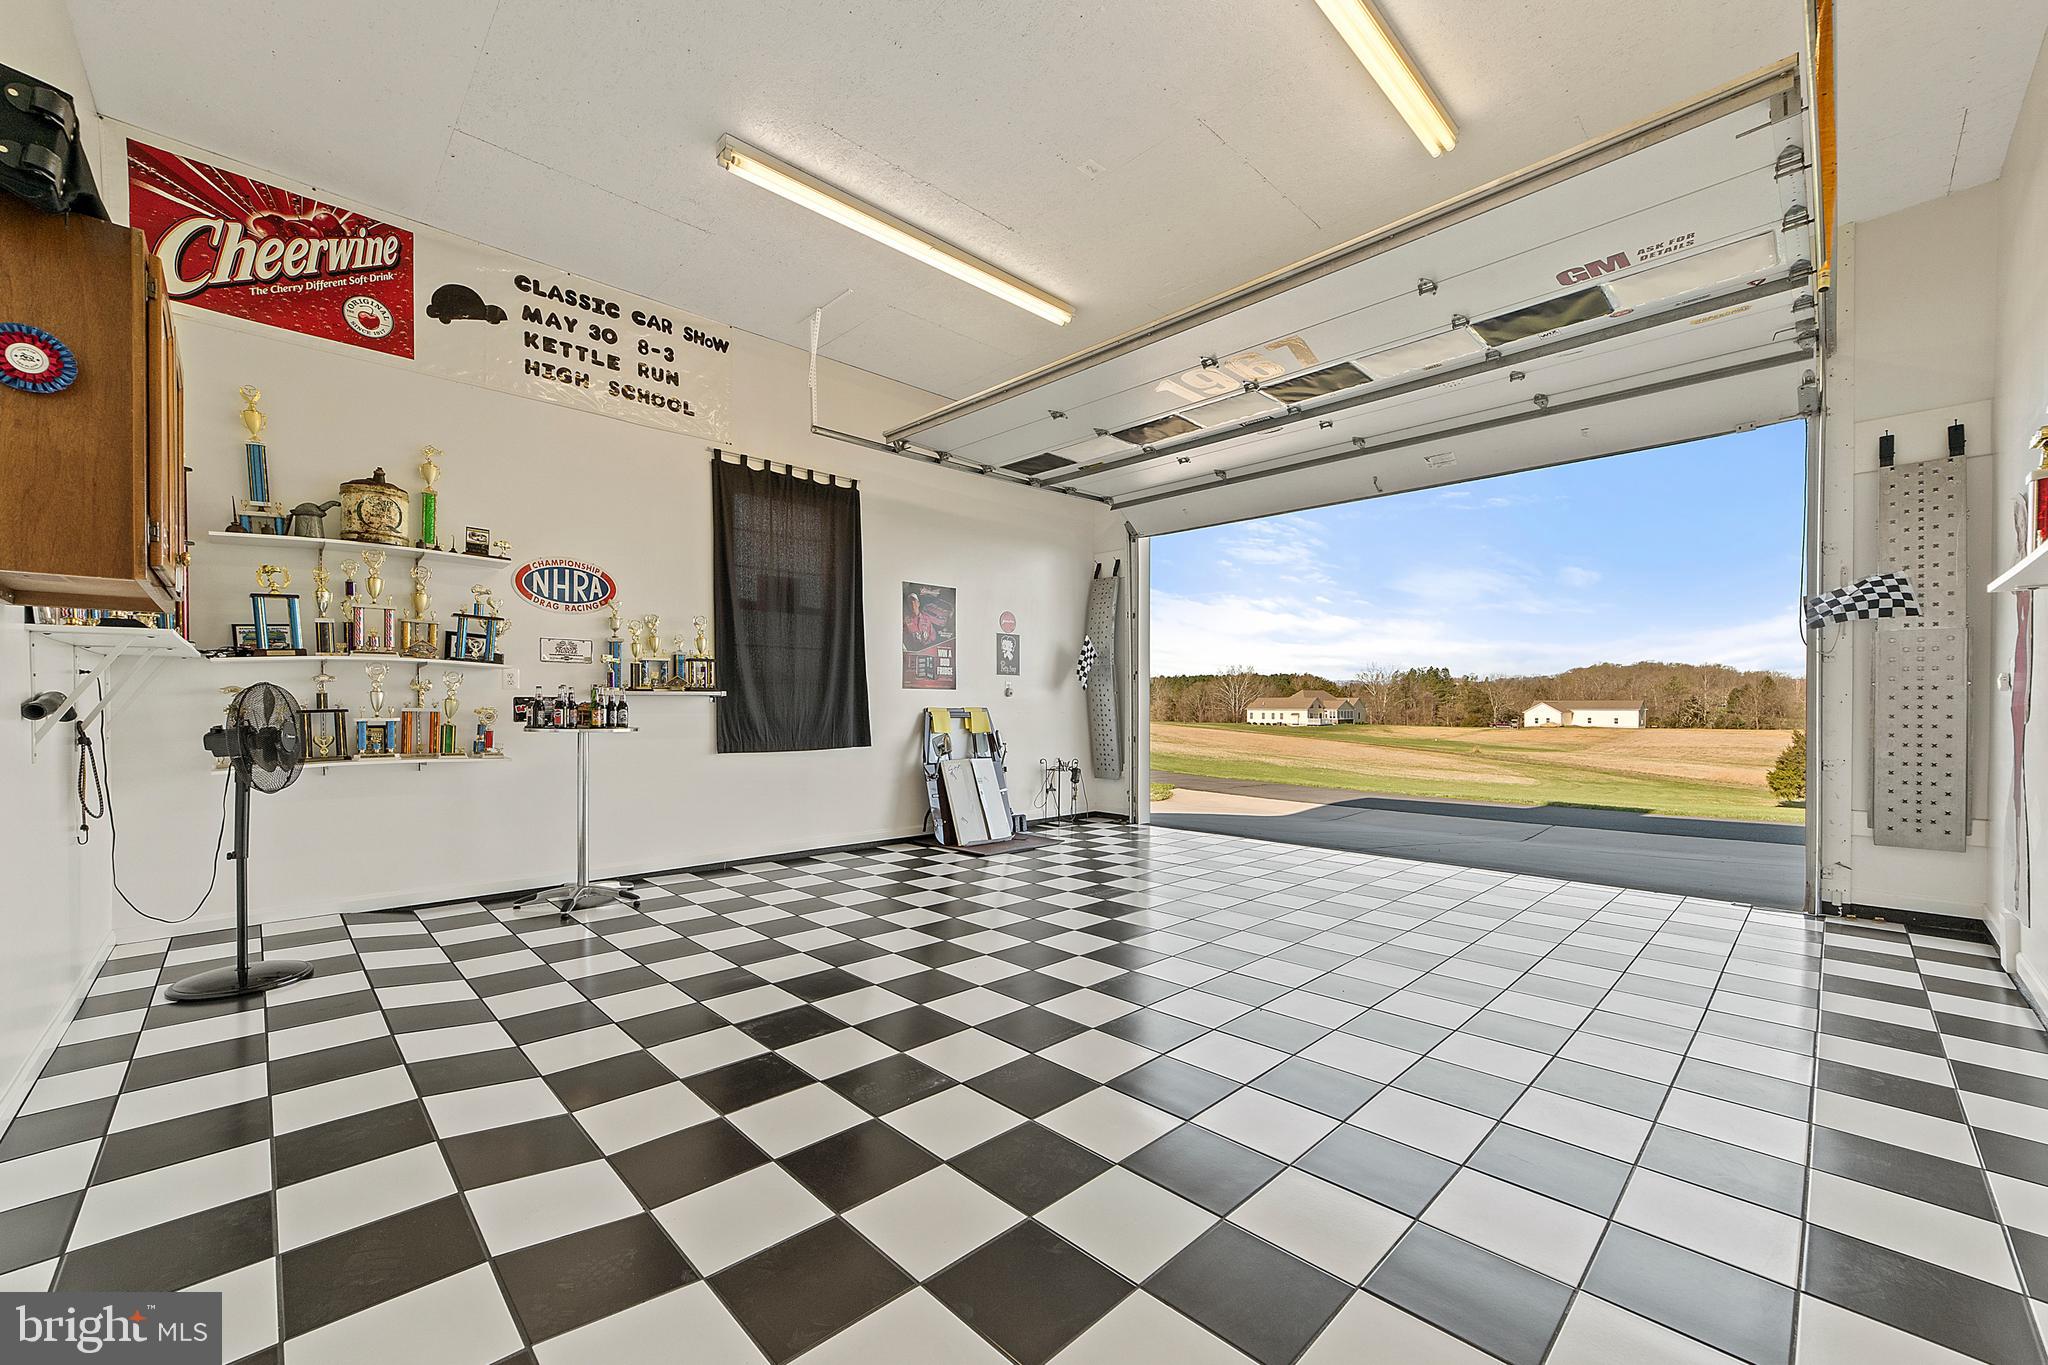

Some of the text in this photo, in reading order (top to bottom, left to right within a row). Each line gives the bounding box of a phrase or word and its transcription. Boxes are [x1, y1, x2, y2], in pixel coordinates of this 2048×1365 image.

[154, 217, 399, 296] Cheerwine
[1636, 232, 1695, 255] ASK FOR
[1640, 239, 1694, 261] DETAILS
[1555, 251, 1631, 286] GM
[249, 272, 394, 296] The Cherry Different Soft Drink
[347, 299, 389, 321] ORIGINAL
[514, 274, 620, 319] CLASSIC
[631, 310, 673, 334] CAR
[350, 321, 371, 335] SINCE
[521, 304, 674, 363] MAY 30 8-3
[523, 331, 680, 387] KETTLE RUN
[1154, 335, 1320, 402] 1967
[524, 358, 696, 417] HIGH SCHOOL
[532, 560, 601, 575] CHAMPIONSHIP
[532, 569, 603, 602] NHRA
[532, 595, 559, 610] DRAG
[564, 603, 599, 612] RACING
